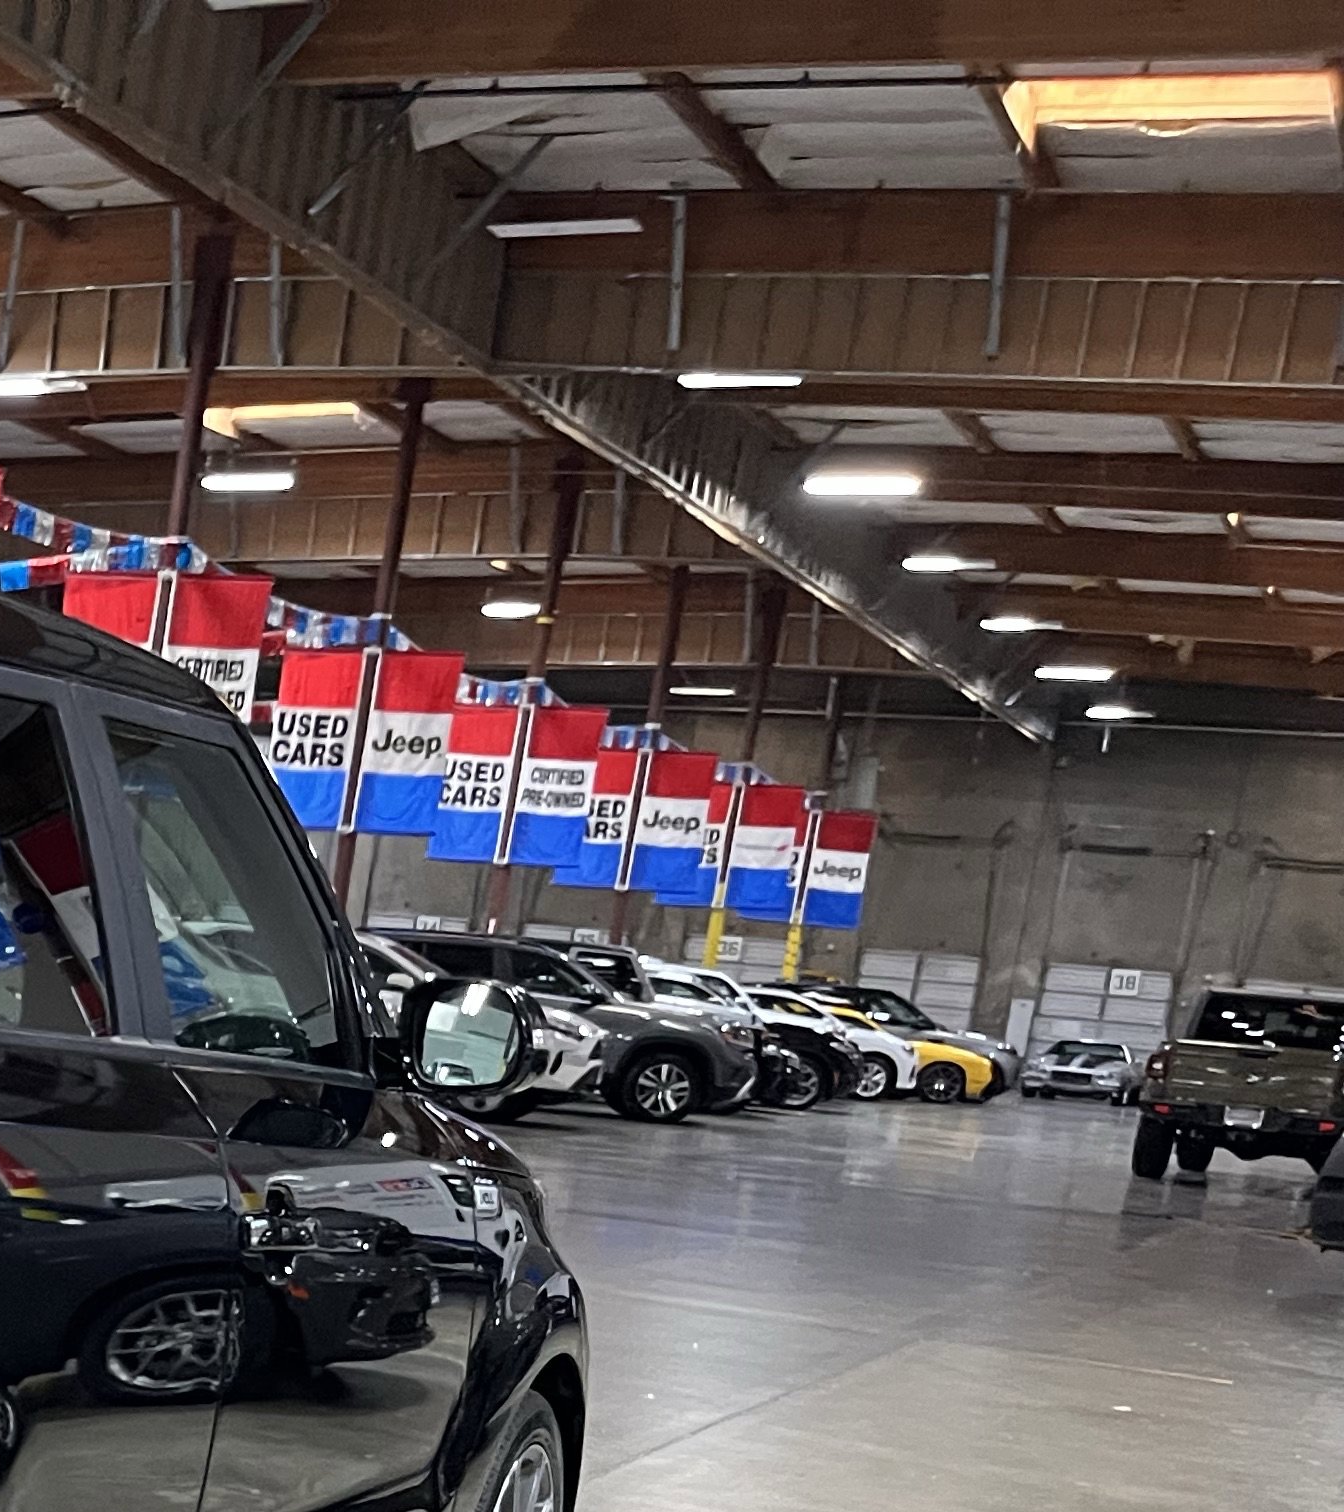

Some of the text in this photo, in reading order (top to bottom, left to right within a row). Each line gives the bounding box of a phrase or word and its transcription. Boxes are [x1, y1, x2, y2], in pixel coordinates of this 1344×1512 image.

[278, 712, 349, 739] USED
[272, 740, 344, 767] CARS
[372, 729, 442, 759] Jeep
[440, 784, 502, 808] CARS
[642, 809, 701, 834] Jeep
[813, 860, 862, 882] Jeep
